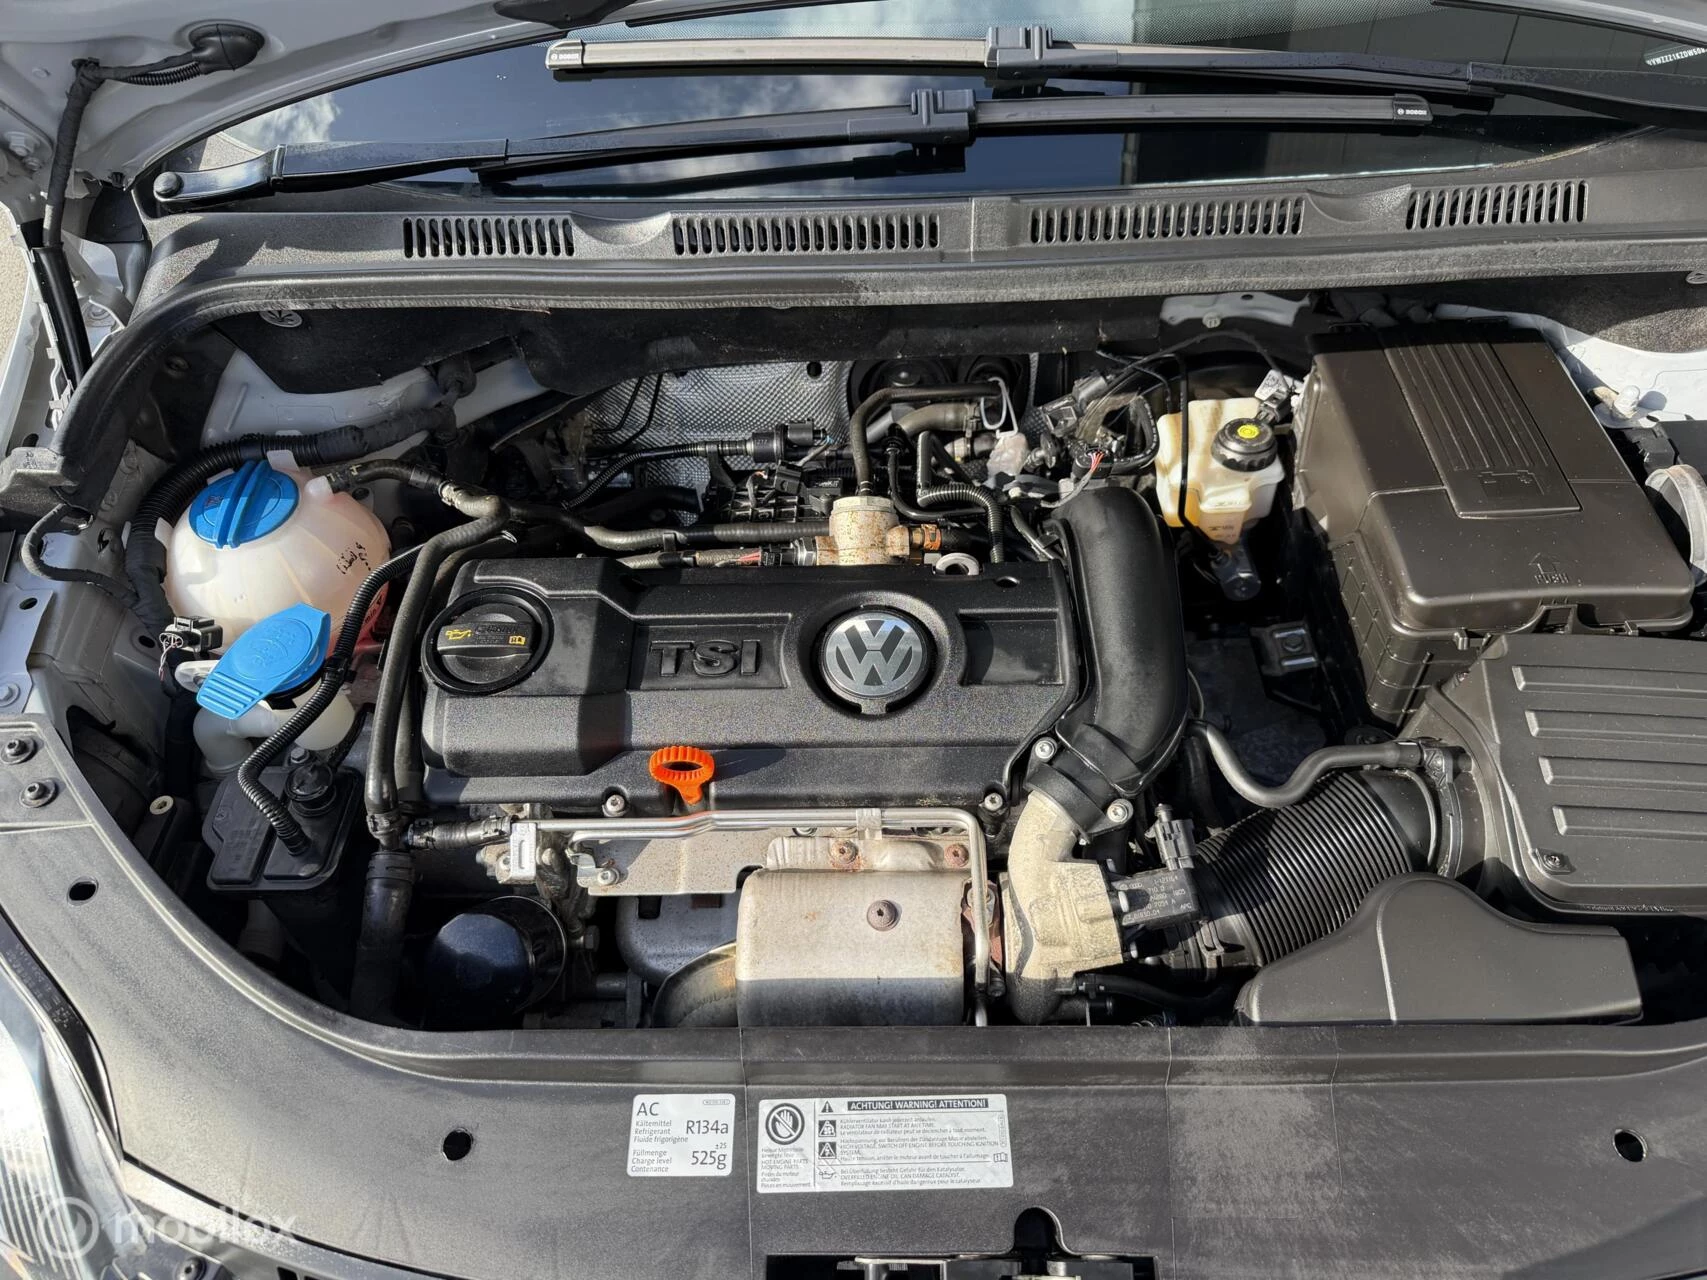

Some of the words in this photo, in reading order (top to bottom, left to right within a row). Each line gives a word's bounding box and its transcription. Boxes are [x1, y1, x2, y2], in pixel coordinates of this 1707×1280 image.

[650, 639, 761, 677] TSI
[636, 1102, 660, 1116] AC
[850, 1101, 894, 1110] ACHTUNG!
[895, 1100, 938, 1109] WARNING!
[939, 1099, 986, 1109] ATTENTION!
[634, 1128, 671, 1136] Refrigerant
[686, 1120, 729, 1135] R134a
[654, 1136, 688, 1144] frigorigène
[633, 1150, 667, 1158] Füllmenge
[632, 1158, 655, 1166] Charge
[691, 1151, 727, 1170] 525g
